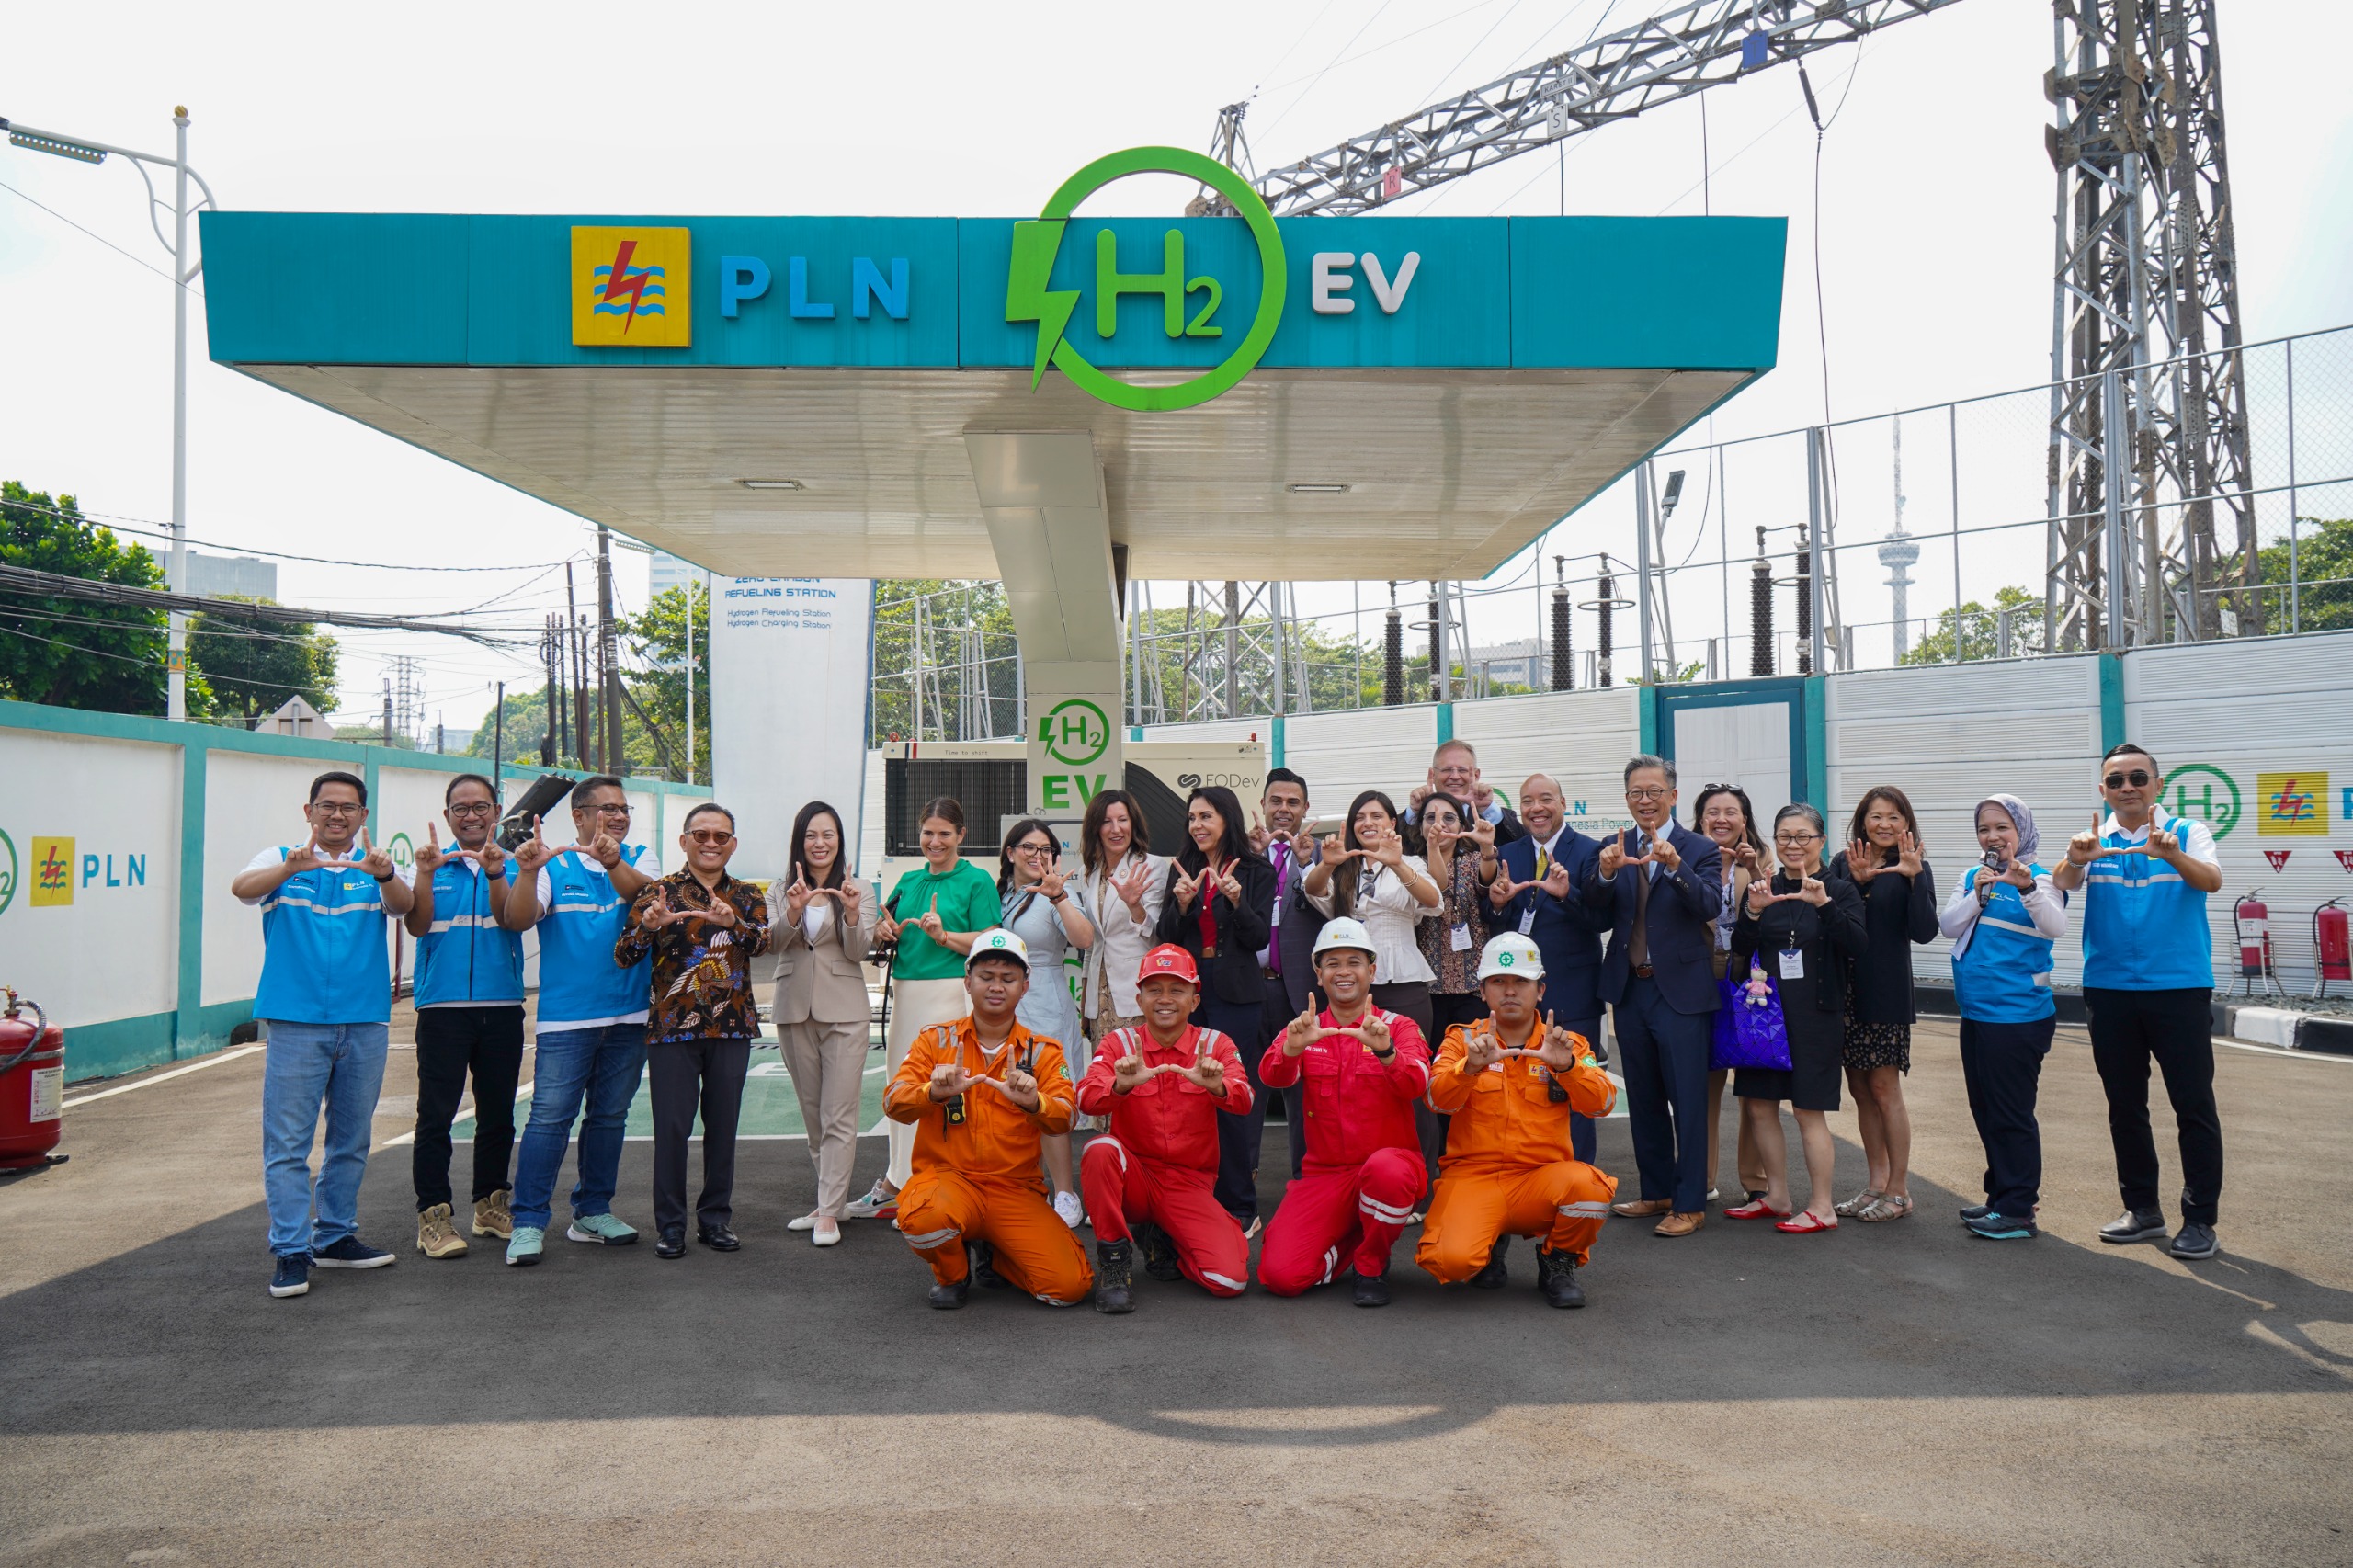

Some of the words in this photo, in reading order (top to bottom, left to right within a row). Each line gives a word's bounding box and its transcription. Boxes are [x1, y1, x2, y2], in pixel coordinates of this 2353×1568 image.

[1544, 79, 1567, 93] KARET
[1552, 112, 1561, 129] S
[1389, 175, 1396, 189] R
[721, 256, 909, 320] PLN
[1312, 251, 1421, 316] EV
[725, 588, 781, 598] REFUELING
[786, 588, 836, 598] STATION
[727, 608, 759, 618] Hydrogen
[761, 608, 800, 618] Refueling
[802, 608, 831, 618] Station
[727, 619, 759, 628] Hydrogen
[761, 619, 799, 629] Charging
[802, 619, 831, 629] Station
[1062, 715, 1101, 748] H2
[1042, 774, 1107, 809] EV
[1601, 817, 1634, 830] Power
[82, 853, 146, 889] PLN
